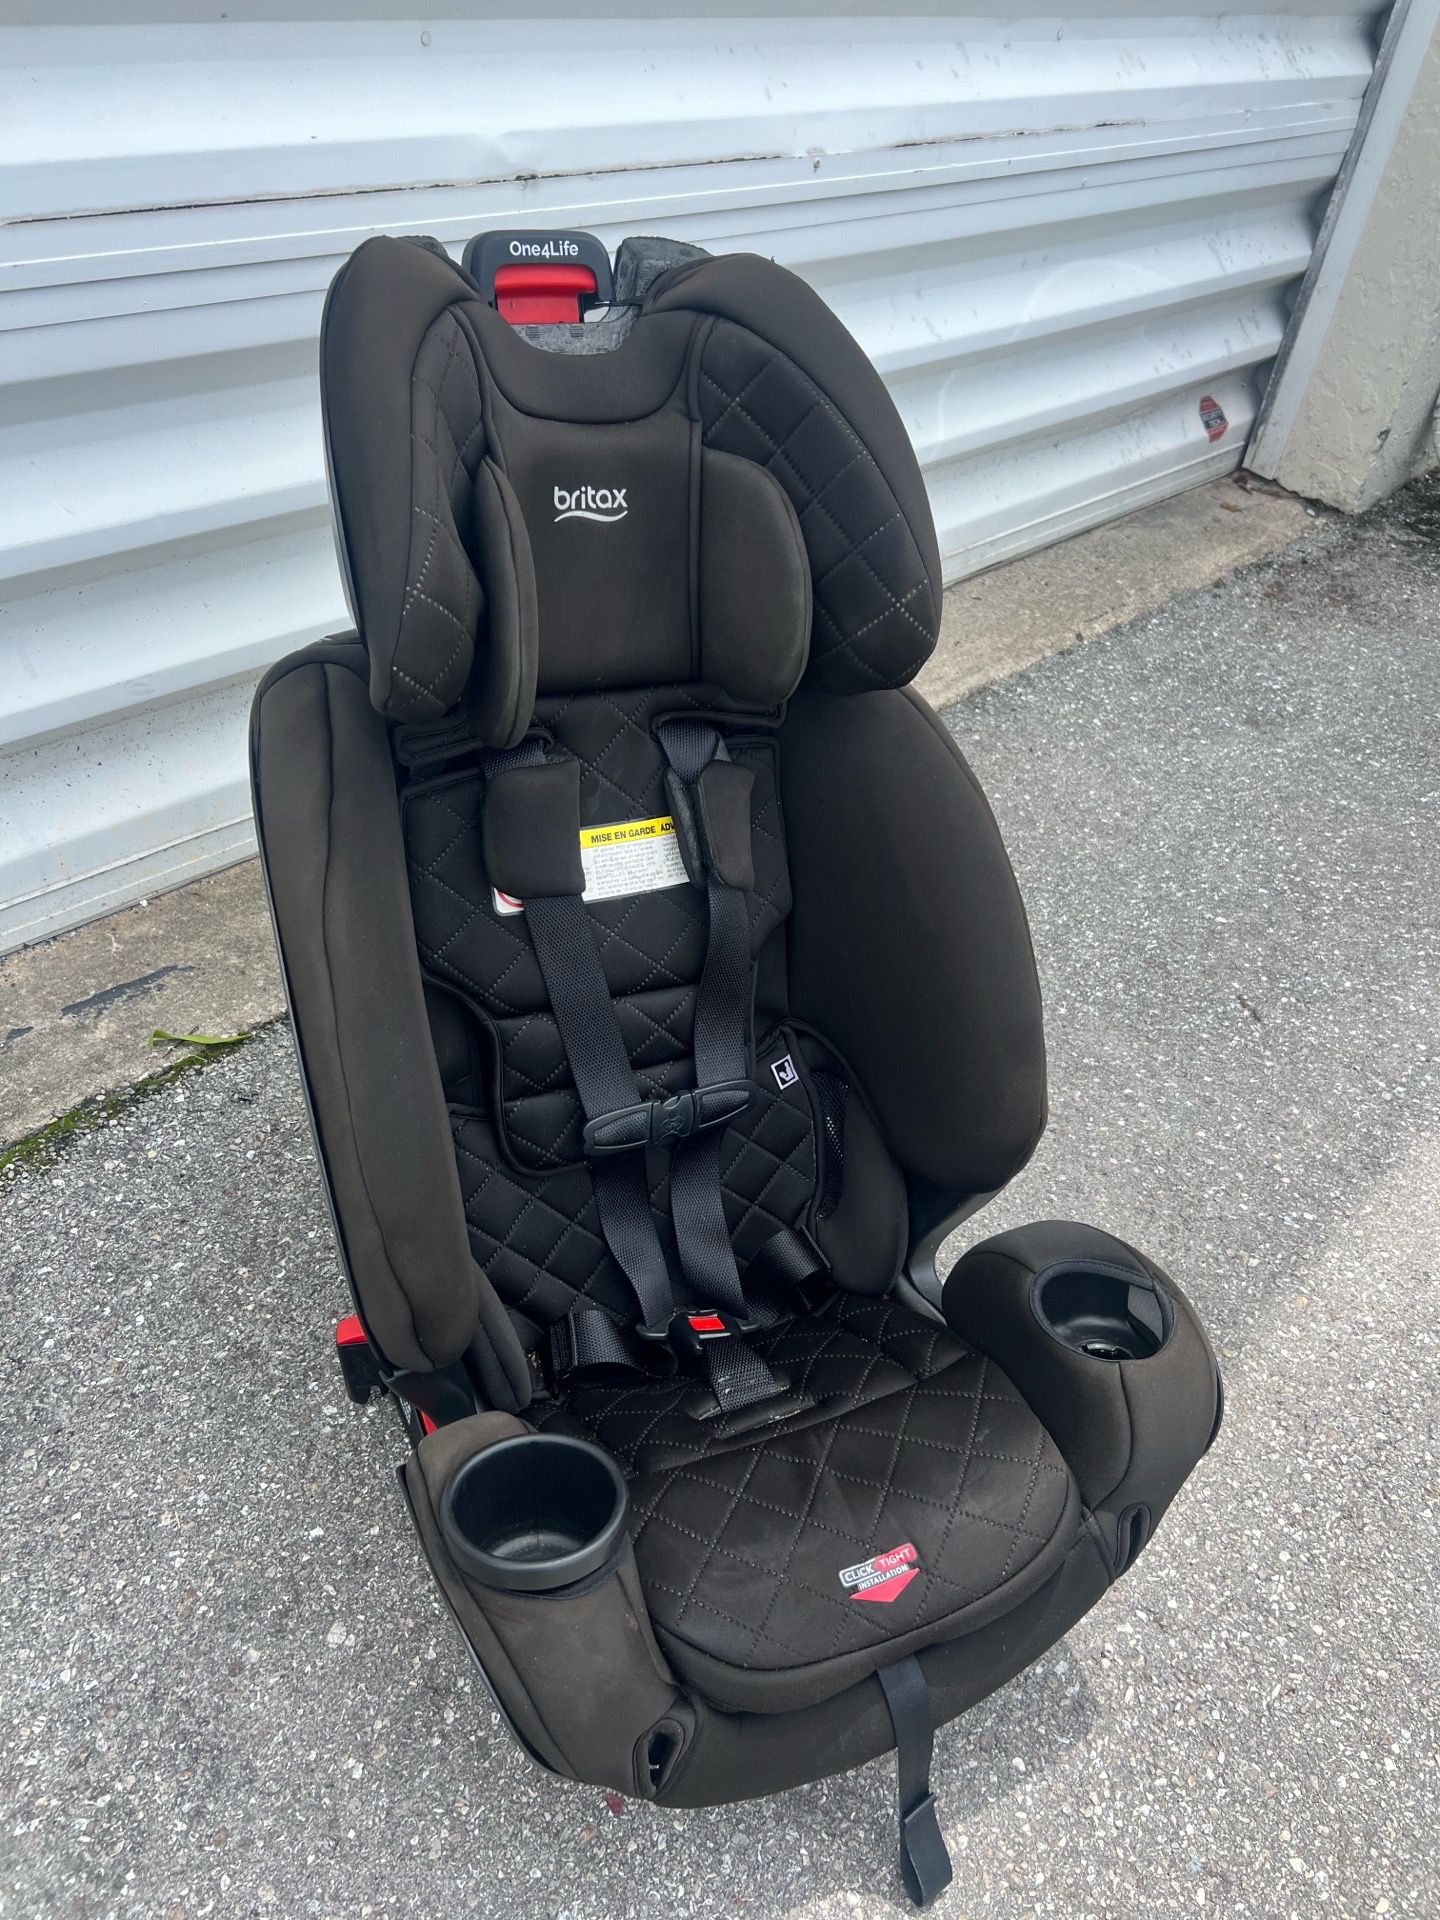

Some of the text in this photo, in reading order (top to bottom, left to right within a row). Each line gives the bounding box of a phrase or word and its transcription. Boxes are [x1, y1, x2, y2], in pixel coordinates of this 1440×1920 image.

[509, 241, 579, 258] One4Life
[553, 486, 628, 511] britax
[591, 825, 656, 843] MISE EN GARDE
[845, 1548, 911, 1582] CLICK TIGHT
[858, 1563, 909, 1591] INSTALLATION
